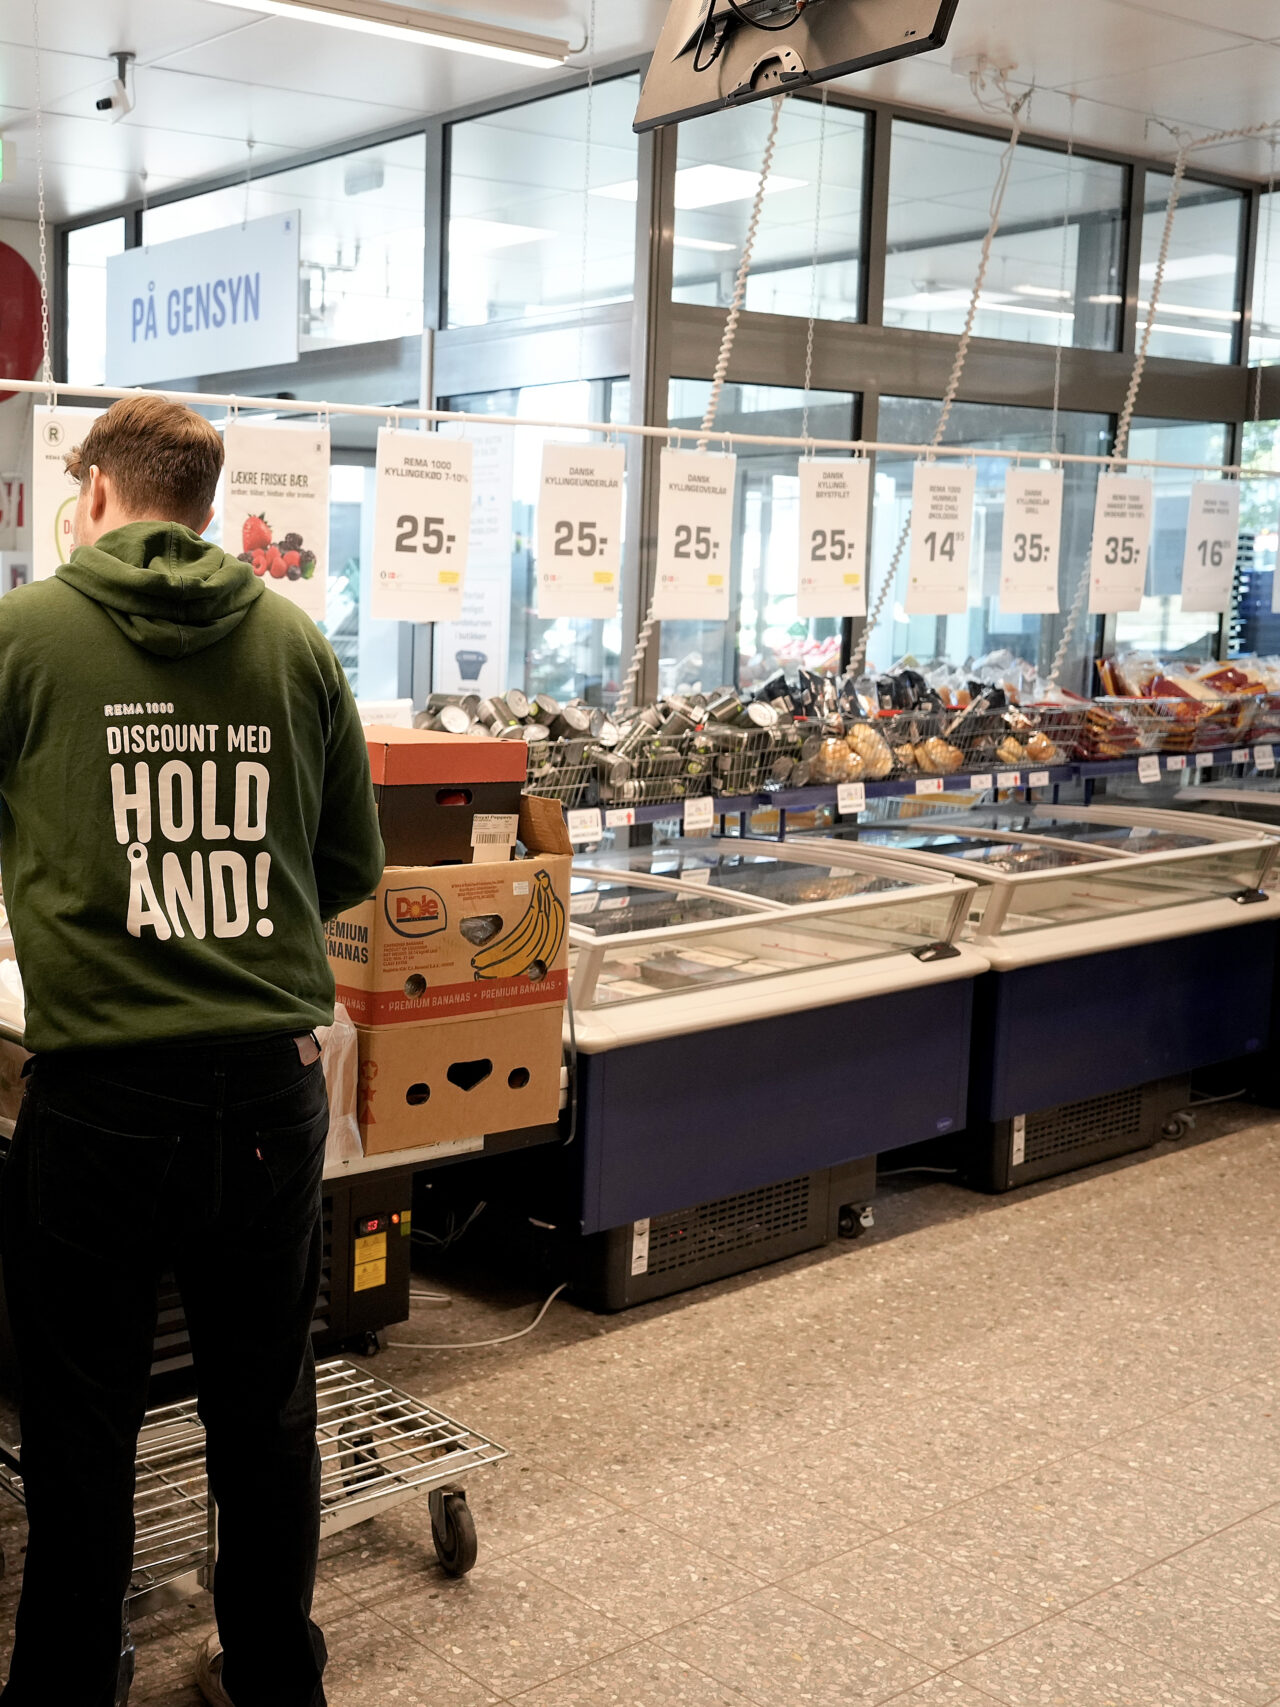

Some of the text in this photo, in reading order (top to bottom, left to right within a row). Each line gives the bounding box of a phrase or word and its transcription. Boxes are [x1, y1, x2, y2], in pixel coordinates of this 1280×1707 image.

[131, 272, 260, 344] PÅ GENSYN
[49, 427, 58, 441] R
[403, 457, 452, 470] REMA 1000
[231, 471, 308, 488] LÆKRE FRISKE BÆR
[384, 466, 442, 481] KYLLINGEKØD
[569, 467, 595, 477] DANSK
[687, 474, 711, 484] DANSK
[822, 471, 844, 480] DANSK
[545, 476, 619, 488] KYLLINGEUNDERLÅR
[104, 702, 174, 716] REMA 1000
[107, 724, 271, 754] DISCOUNT MED
[110, 760, 270, 844] HOLD
[126, 842, 274, 940] ÅND!
[396, 894, 438, 919] Dole
[481, 981, 555, 999] PREMIUM BANANAS
[389, 992, 471, 1011] PREMIUM BANANAS
